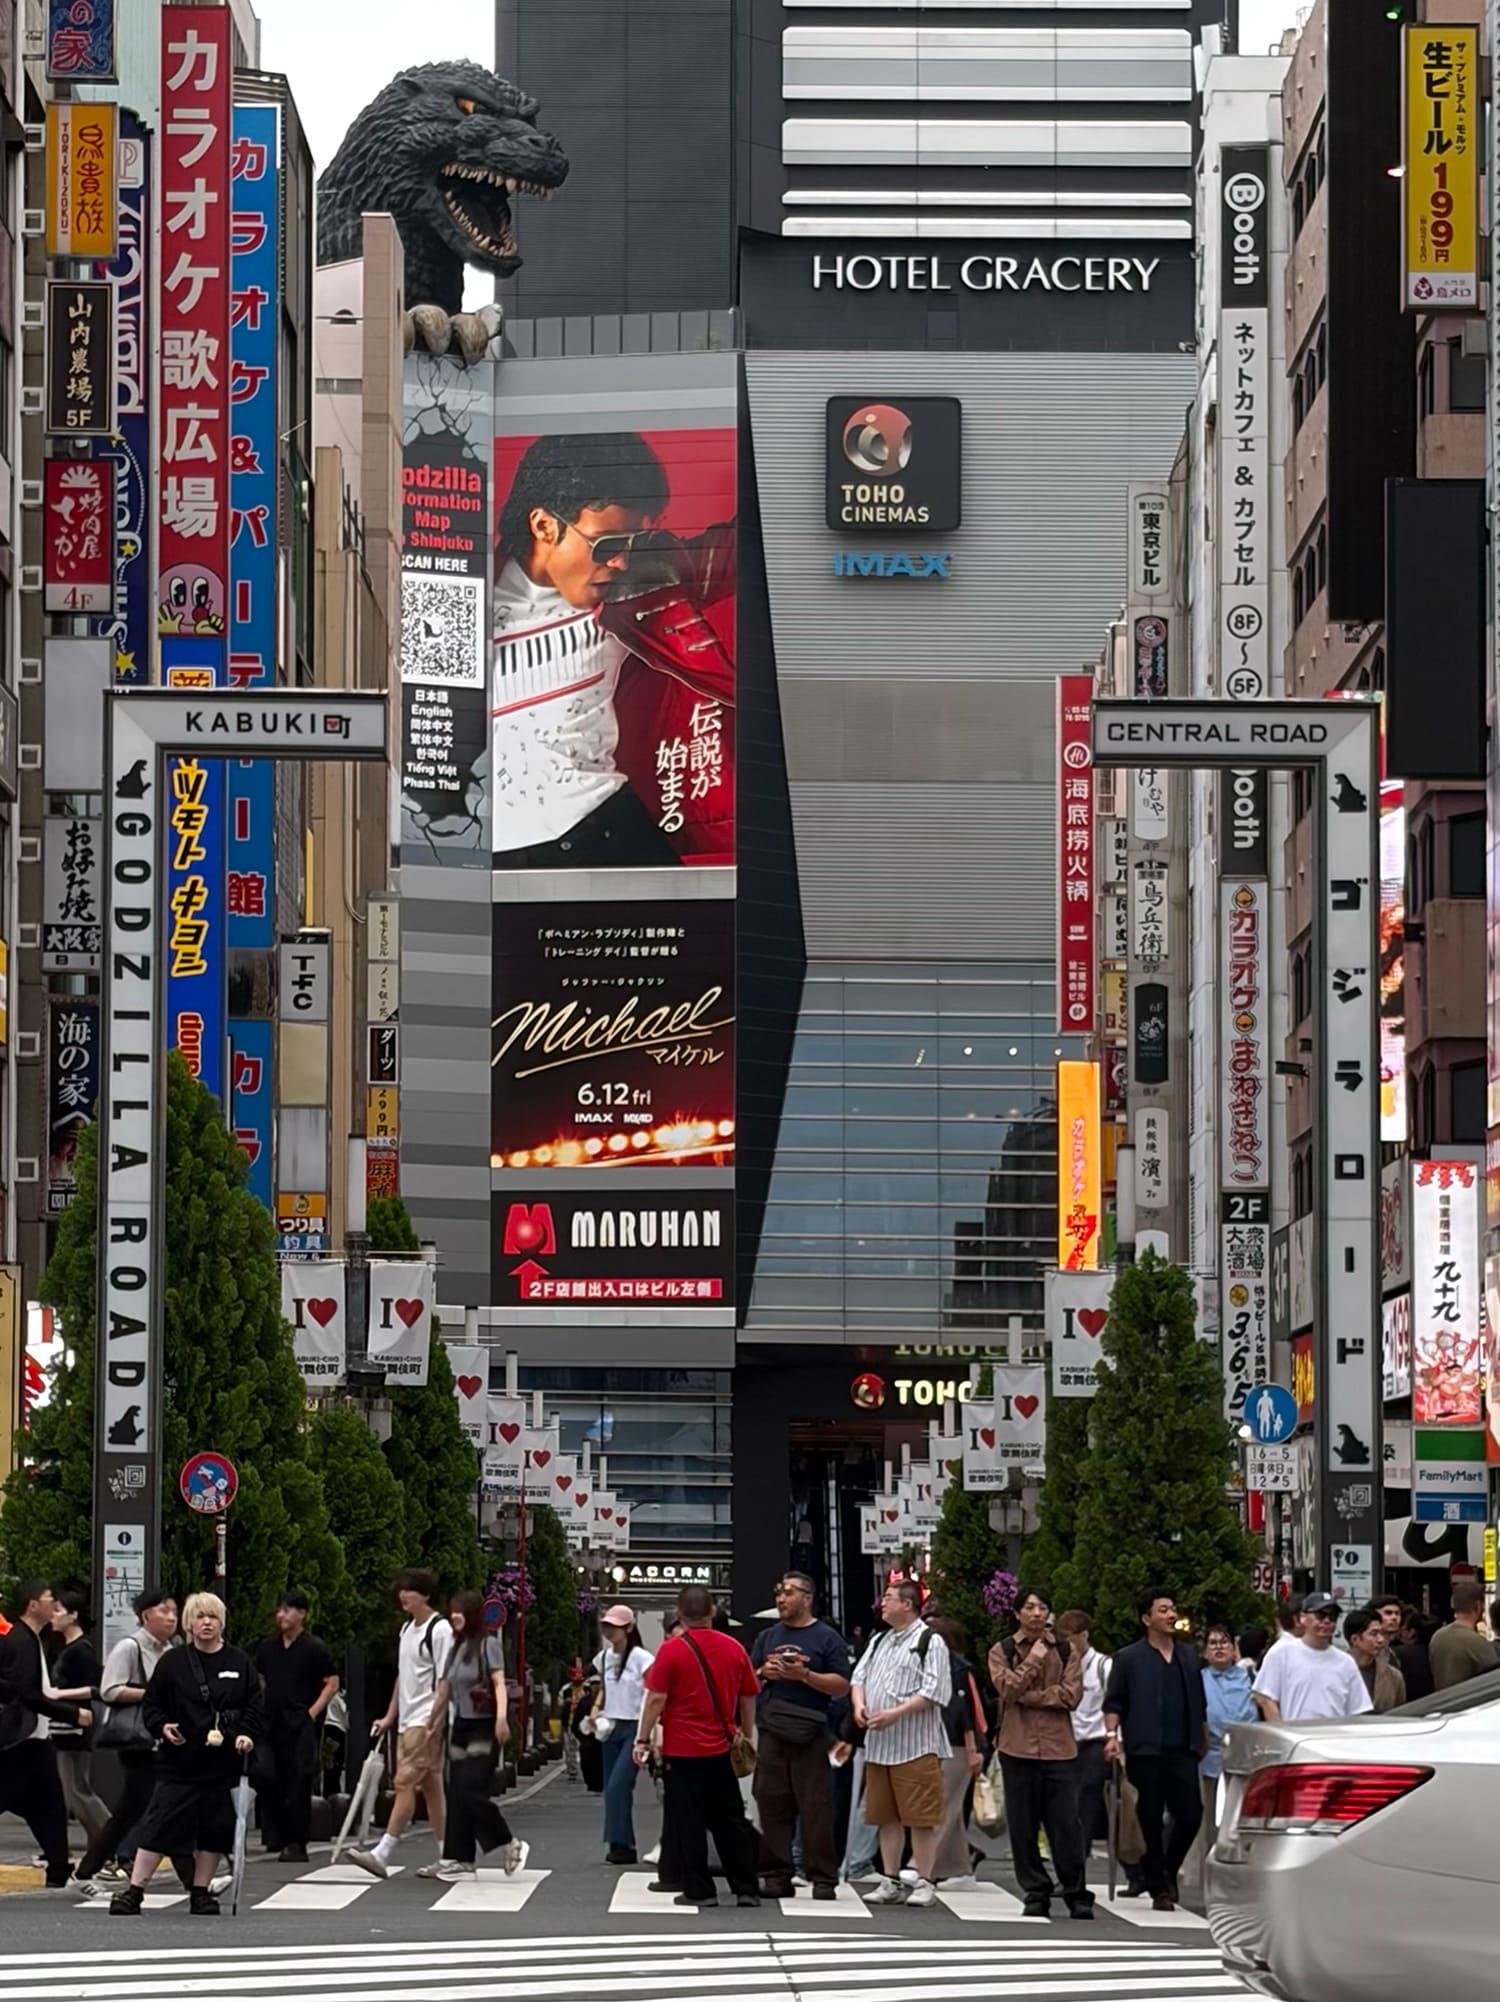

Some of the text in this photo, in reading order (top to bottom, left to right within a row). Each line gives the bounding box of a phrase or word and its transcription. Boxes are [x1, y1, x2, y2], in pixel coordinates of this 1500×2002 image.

[1423, 41, 1454, 263] 生ビール 199円
[60, 122, 69, 235] TORIKIZOKU
[1224, 172, 1265, 285] Booth
[161, 28, 220, 540] カラオケ歌広場
[812, 255, 1160, 293] HOTEL GRACERY
[66, 292, 94, 404] 山内農場
[66, 409, 93, 427] 5F
[1233, 322, 1256, 586] ネットカフェ & カプセル
[401, 463, 482, 493] odzilla
[841, 484, 905, 505] TOHO
[414, 510, 451, 532] Map
[841, 506, 930, 523] CINEMAS
[410, 531, 474, 552] Shinjuku
[1142, 513, 1161, 587] 東京ビル
[434, 555, 468, 573] HERE
[832, 551, 952, 577] IMAX
[63, 587, 93, 609] 4F
[411, 703, 454, 719] English
[415, 689, 449, 704] 日本語
[688, 700, 723, 801] 伝説が
[1107, 722, 1328, 744] CENTRAL ROAD
[404, 776, 461, 791] Phasa Thai
[655, 736, 688, 833] 始まる
[1233, 768, 1260, 850] ooth
[1065, 777, 1090, 903] 海底捞火锅
[58, 820, 97, 923] お好み焼
[171, 758, 209, 977] ツモトキヨシ
[490, 985, 736, 1069] Michael
[58, 1013, 92, 1108] 海の家
[380, 1029, 395, 1072] ダーツ
[645, 1047, 725, 1067] マイケル
[1228, 909, 1262, 1184] カラオケ まねきねこ
[107, 811, 152, 1388] GODZILLA ROAD
[577, 1082, 652, 1107] 6.12 fri
[575, 1112, 614, 1123] IMAX
[1331, 877, 1368, 1365] ゴジラロード
[279, 1217, 325, 1233] つり具
[1229, 1196, 1262, 1220] 2F
[570, 1210, 721, 1248] MARUHAN
[1430, 1261, 1463, 1323] 九十九
[296, 1355, 340, 1363] ABUKI-CHO
[1418, 1467, 1483, 1484] FamilyMart
[629, 1565, 711, 1578] ACORN
